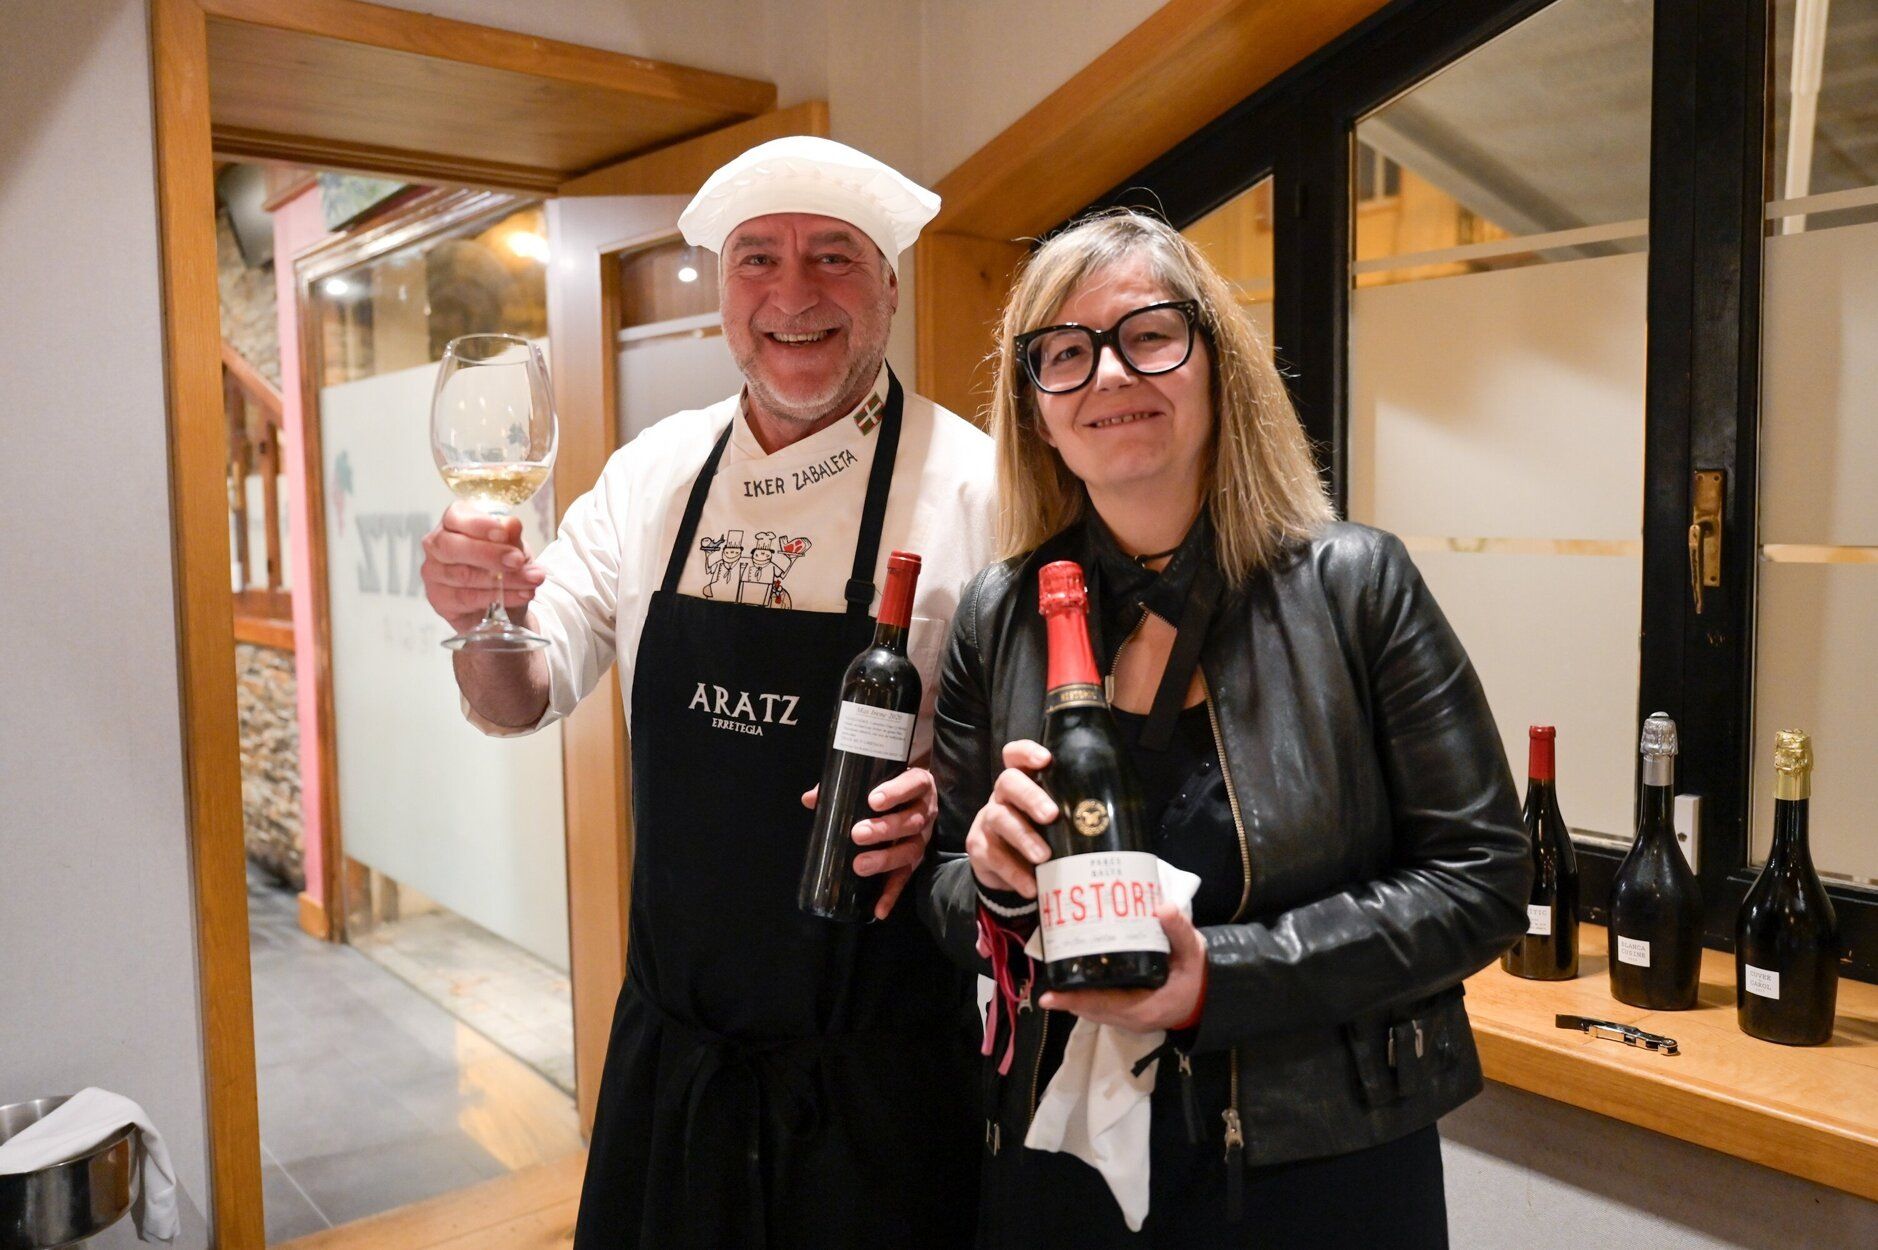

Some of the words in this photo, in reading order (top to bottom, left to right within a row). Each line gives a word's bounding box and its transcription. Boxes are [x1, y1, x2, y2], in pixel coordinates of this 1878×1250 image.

[743, 477, 785, 497] IKER
[792, 449, 858, 490] ZABALETA
[688, 682, 800, 726] ARATZ
[711, 717, 764, 737] ERRETEGIA
